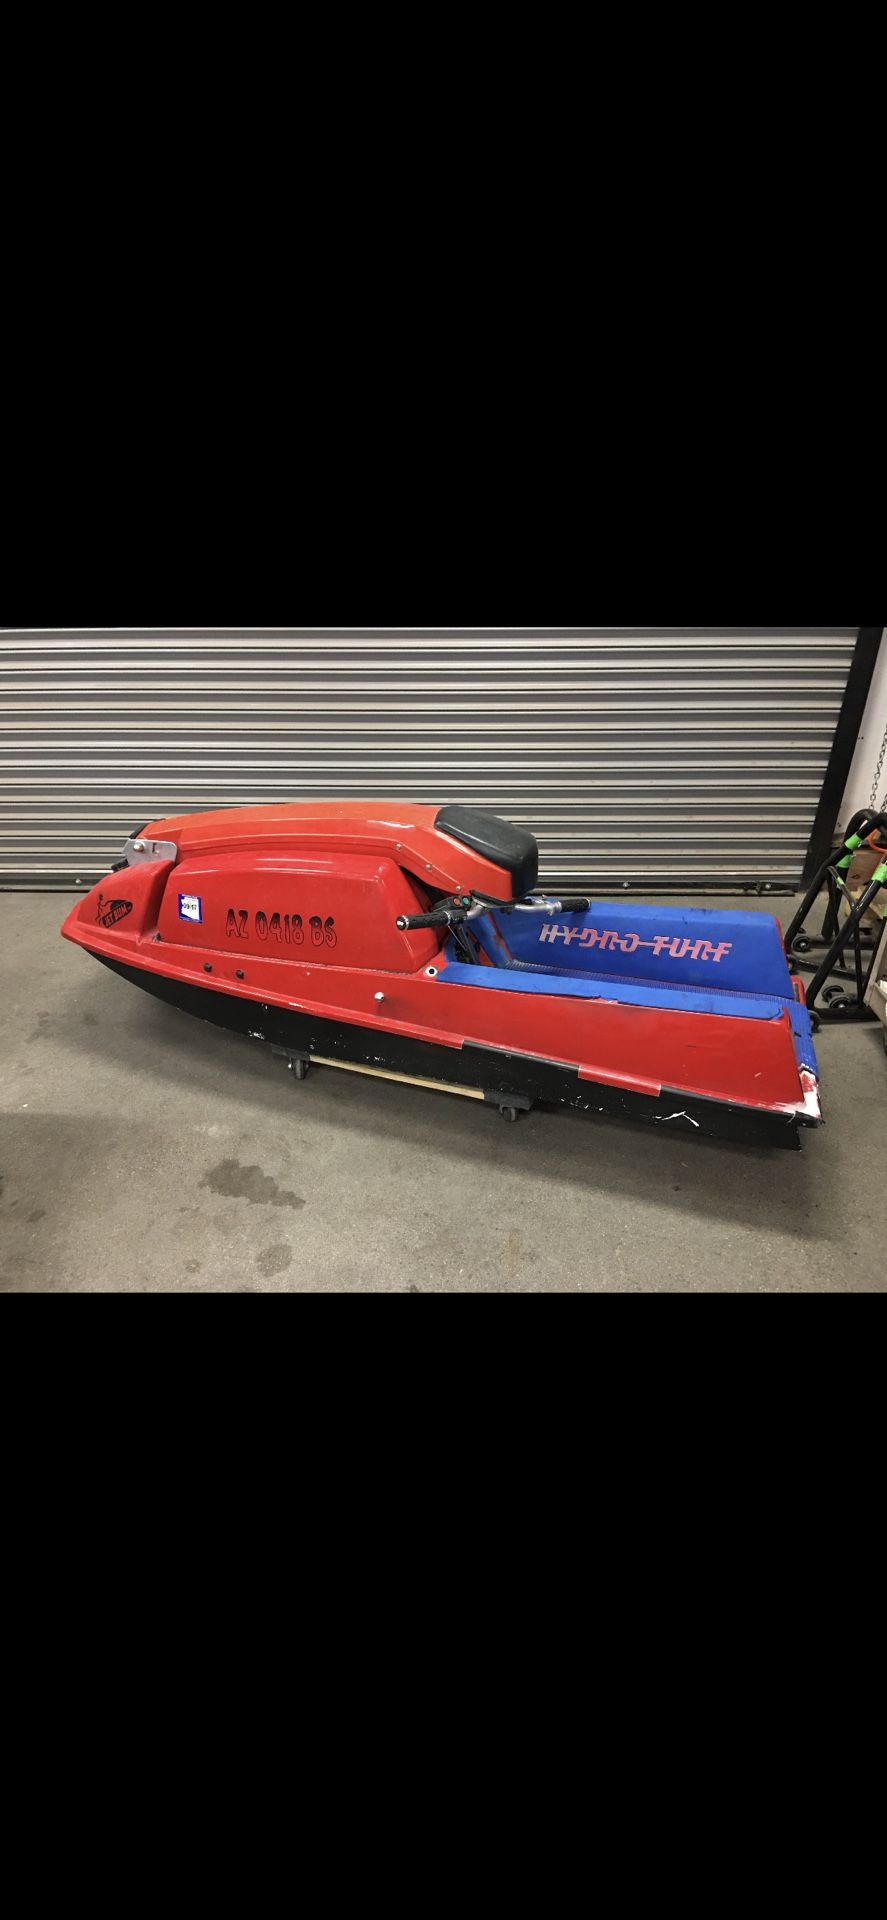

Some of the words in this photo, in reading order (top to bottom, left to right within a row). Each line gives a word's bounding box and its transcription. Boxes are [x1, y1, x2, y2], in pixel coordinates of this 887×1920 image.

[226, 908, 248, 939] AZ
[255, 910, 304, 945] 0418
[309, 915, 337, 948] BS
[538, 923, 640, 953] HYDRO
[653, 935, 733, 963] TURF
